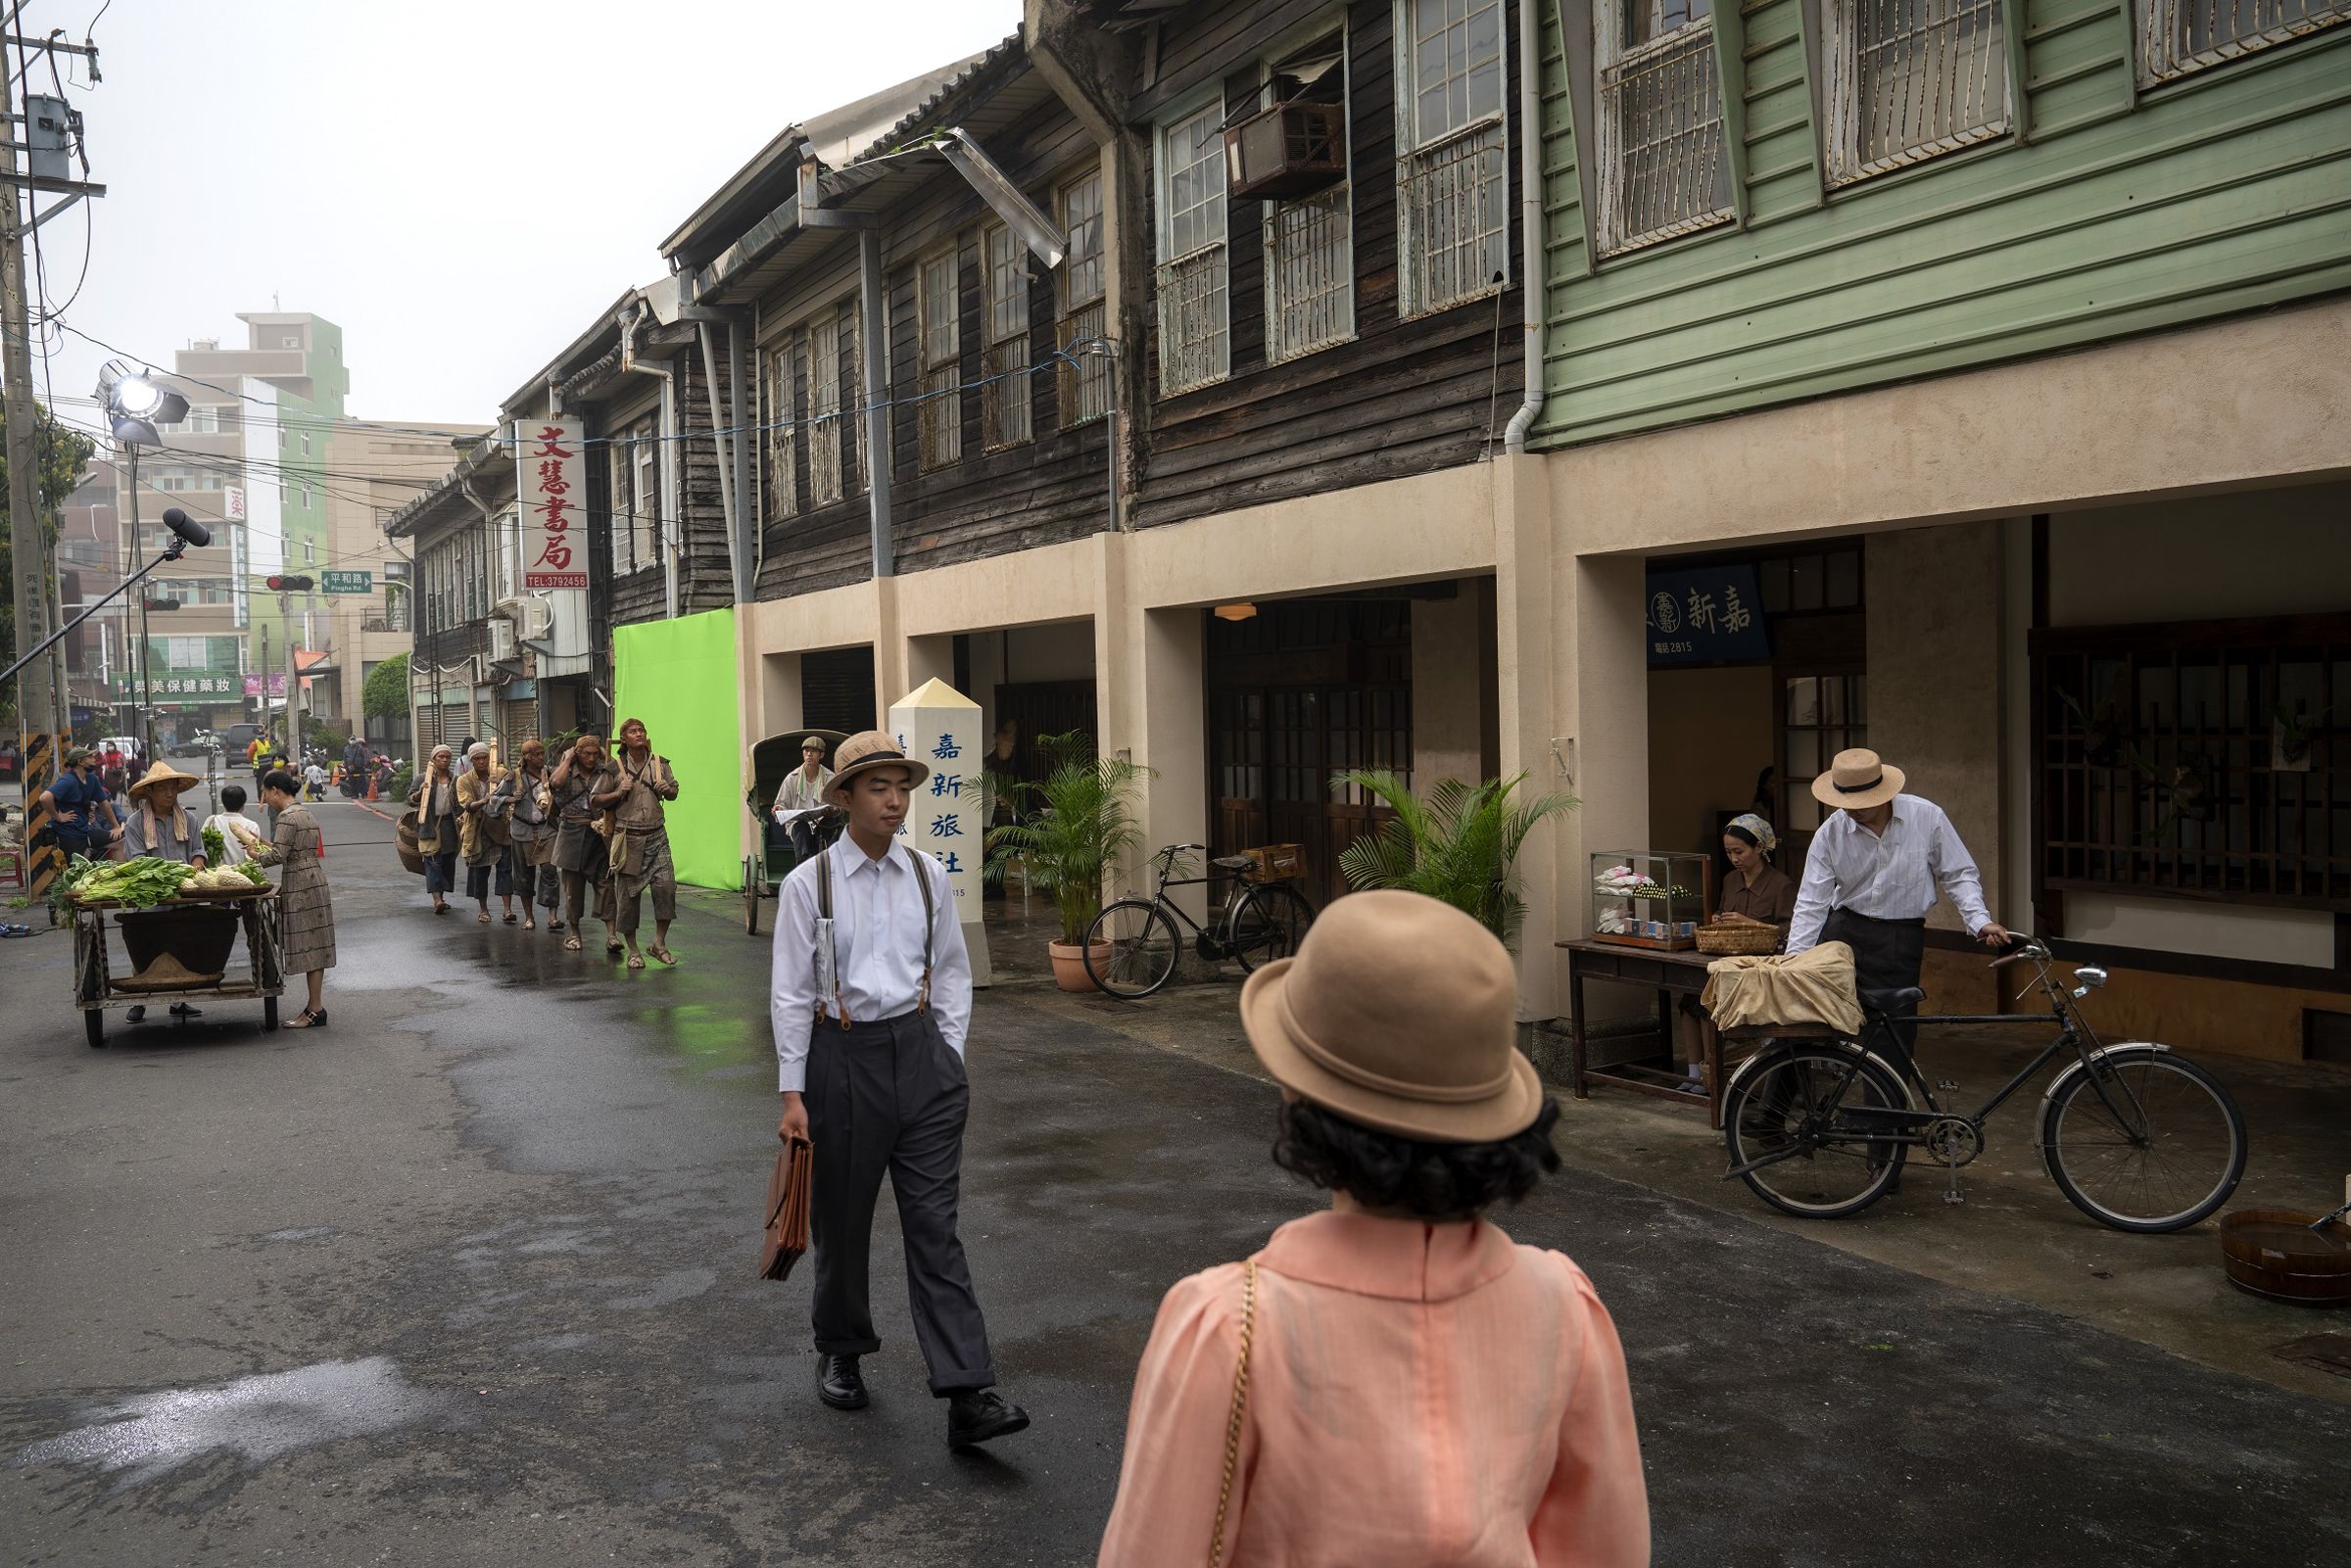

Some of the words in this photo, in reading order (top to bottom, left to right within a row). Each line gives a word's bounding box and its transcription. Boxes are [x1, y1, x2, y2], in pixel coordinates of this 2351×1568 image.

[533, 426, 575, 570] 文慧書局
[330, 573, 362, 584] 平和路
[528, 576, 586, 587] TEL:3792456
[135, 679, 230, 693] 榮美保健藥妝
[930, 733, 965, 874] 嘉新旅社
